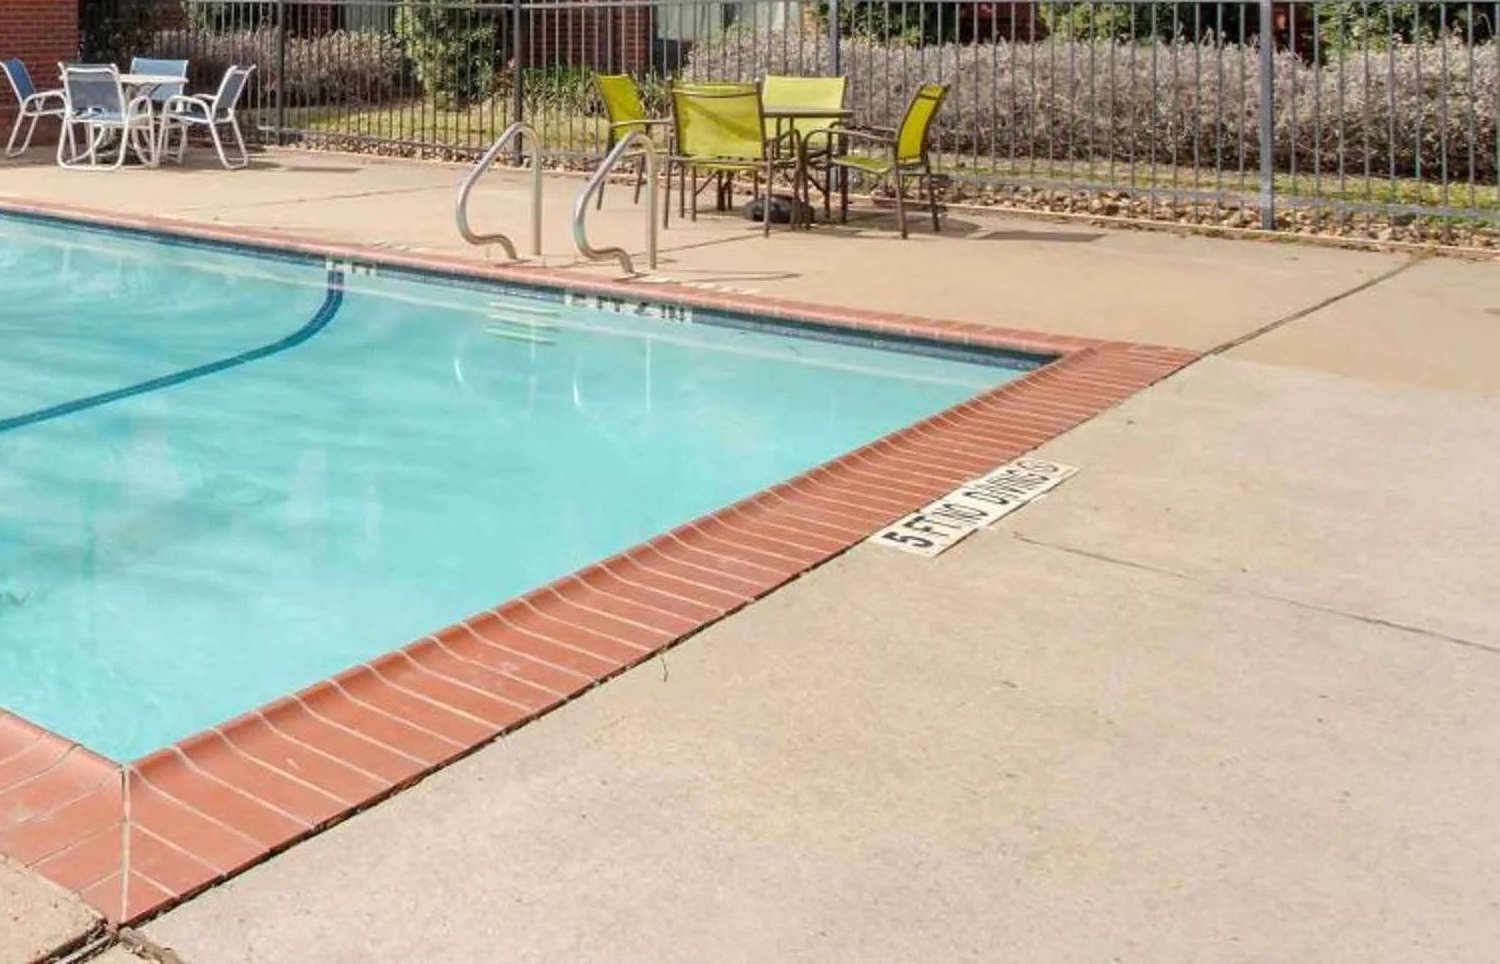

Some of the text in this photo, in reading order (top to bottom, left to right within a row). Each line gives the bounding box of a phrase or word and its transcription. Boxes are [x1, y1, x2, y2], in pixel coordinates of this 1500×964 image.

[902, 514, 962, 537] FT
[930, 502, 989, 527] NO
[881, 530, 935, 549] 5
